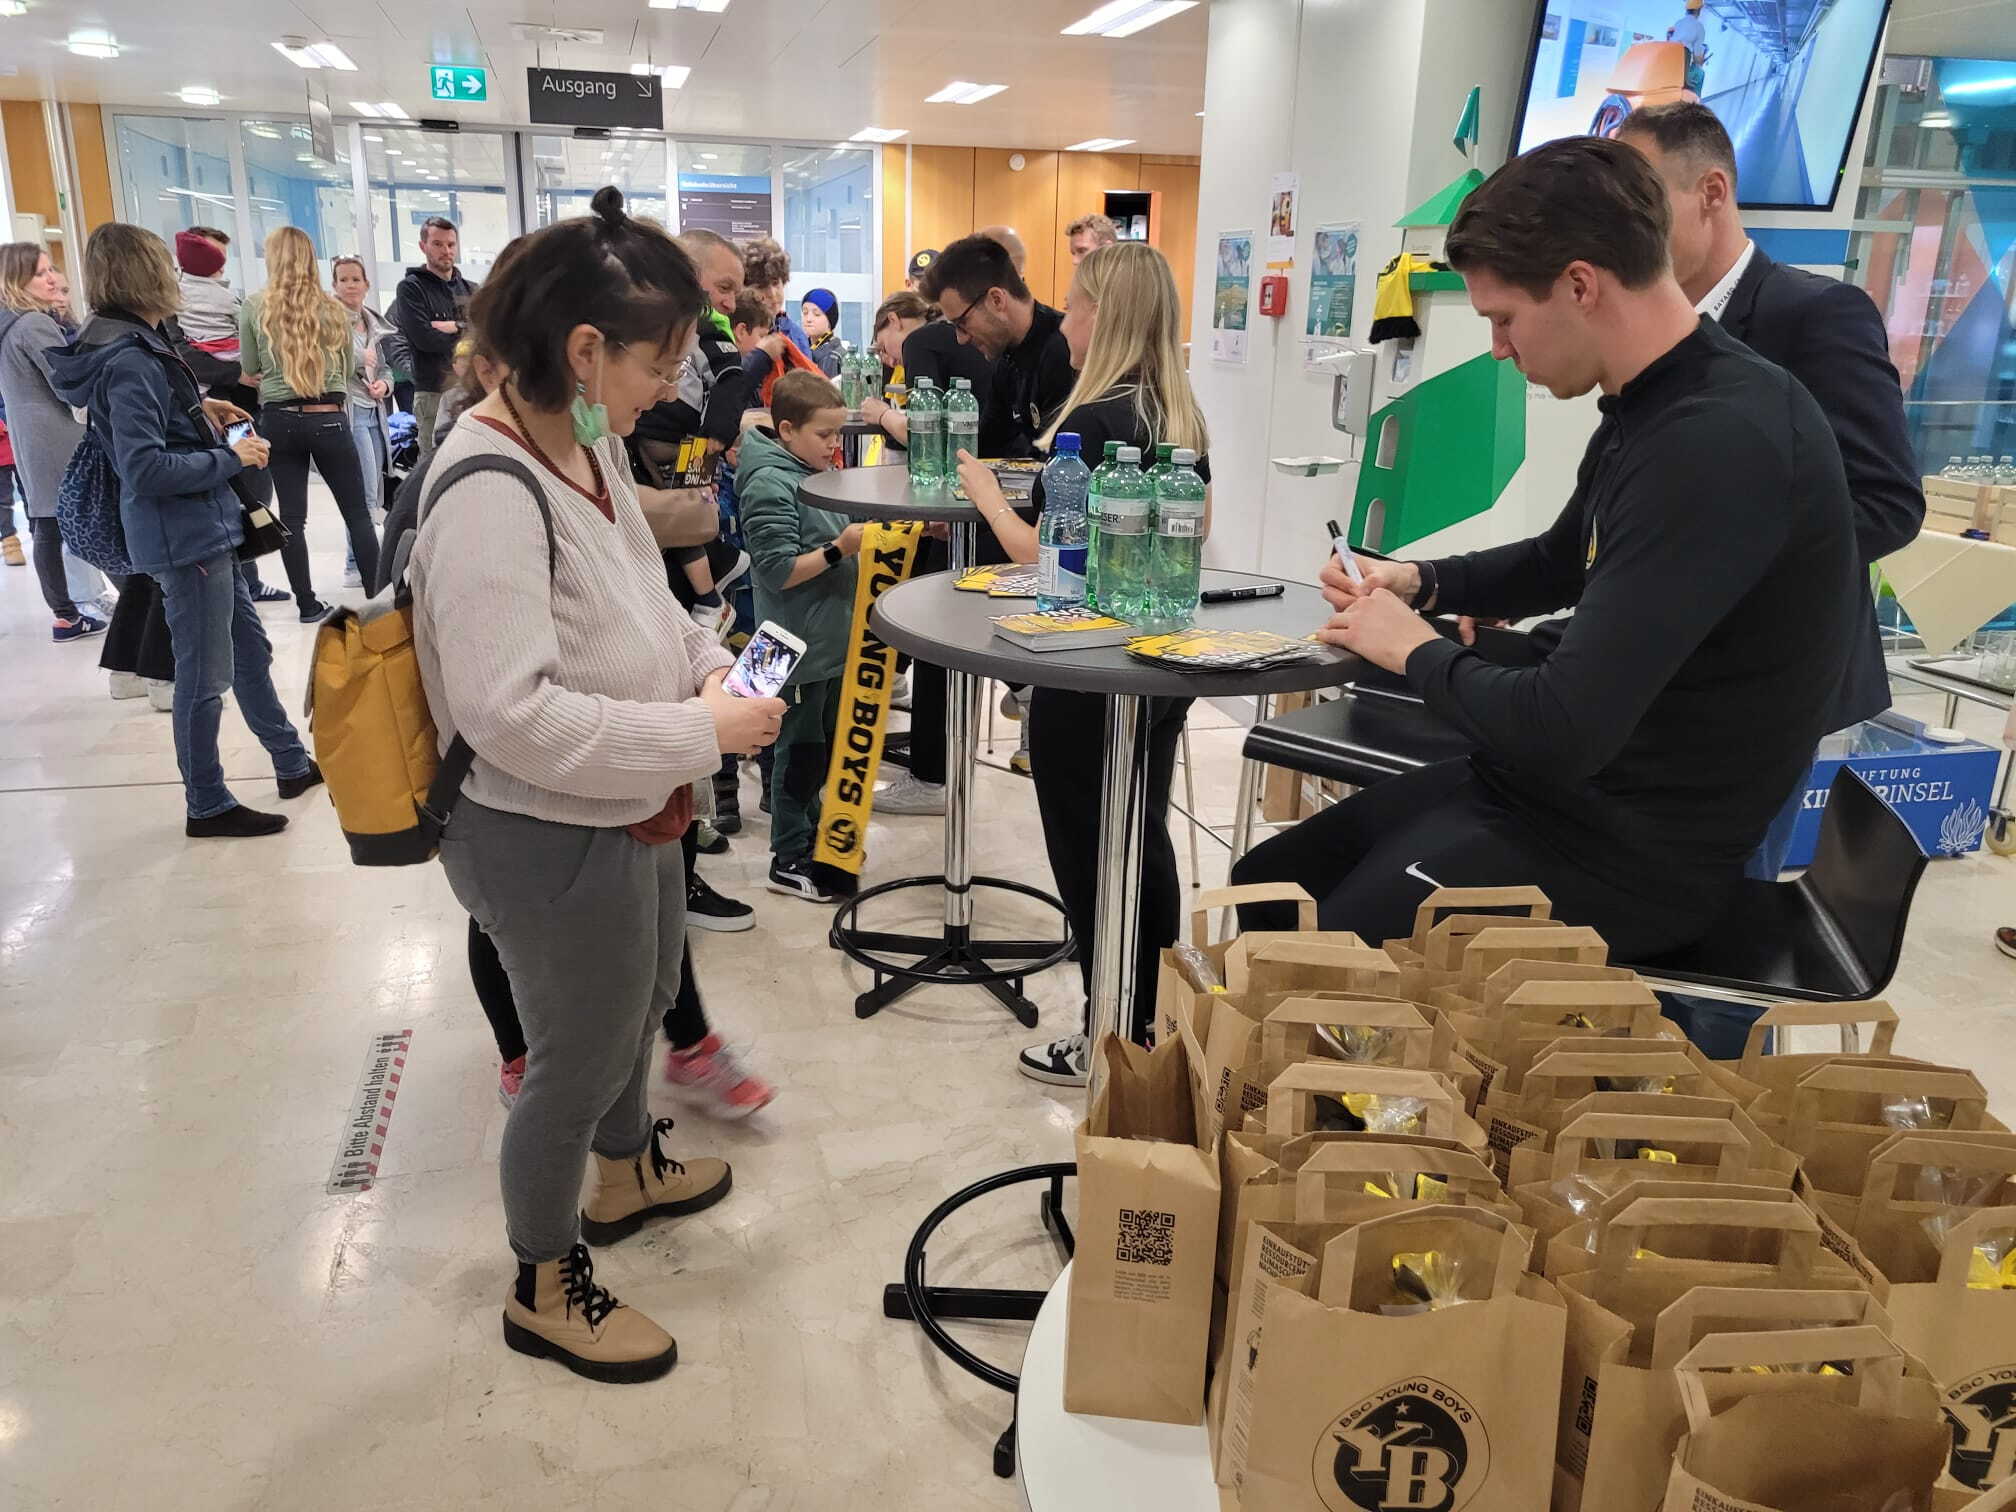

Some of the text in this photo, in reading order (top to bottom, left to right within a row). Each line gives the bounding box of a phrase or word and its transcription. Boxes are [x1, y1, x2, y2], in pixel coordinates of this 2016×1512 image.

[542, 75, 617, 99] Ausgang
[857, 547, 907, 690] YONG
[838, 698, 880, 807] BOYS
[344, 1056, 391, 1158] Bitte Abstand halten
[1340, 1382, 1472, 1429] BSC YOUNG BOYS
[1948, 1376, 1985, 1401] BSC
